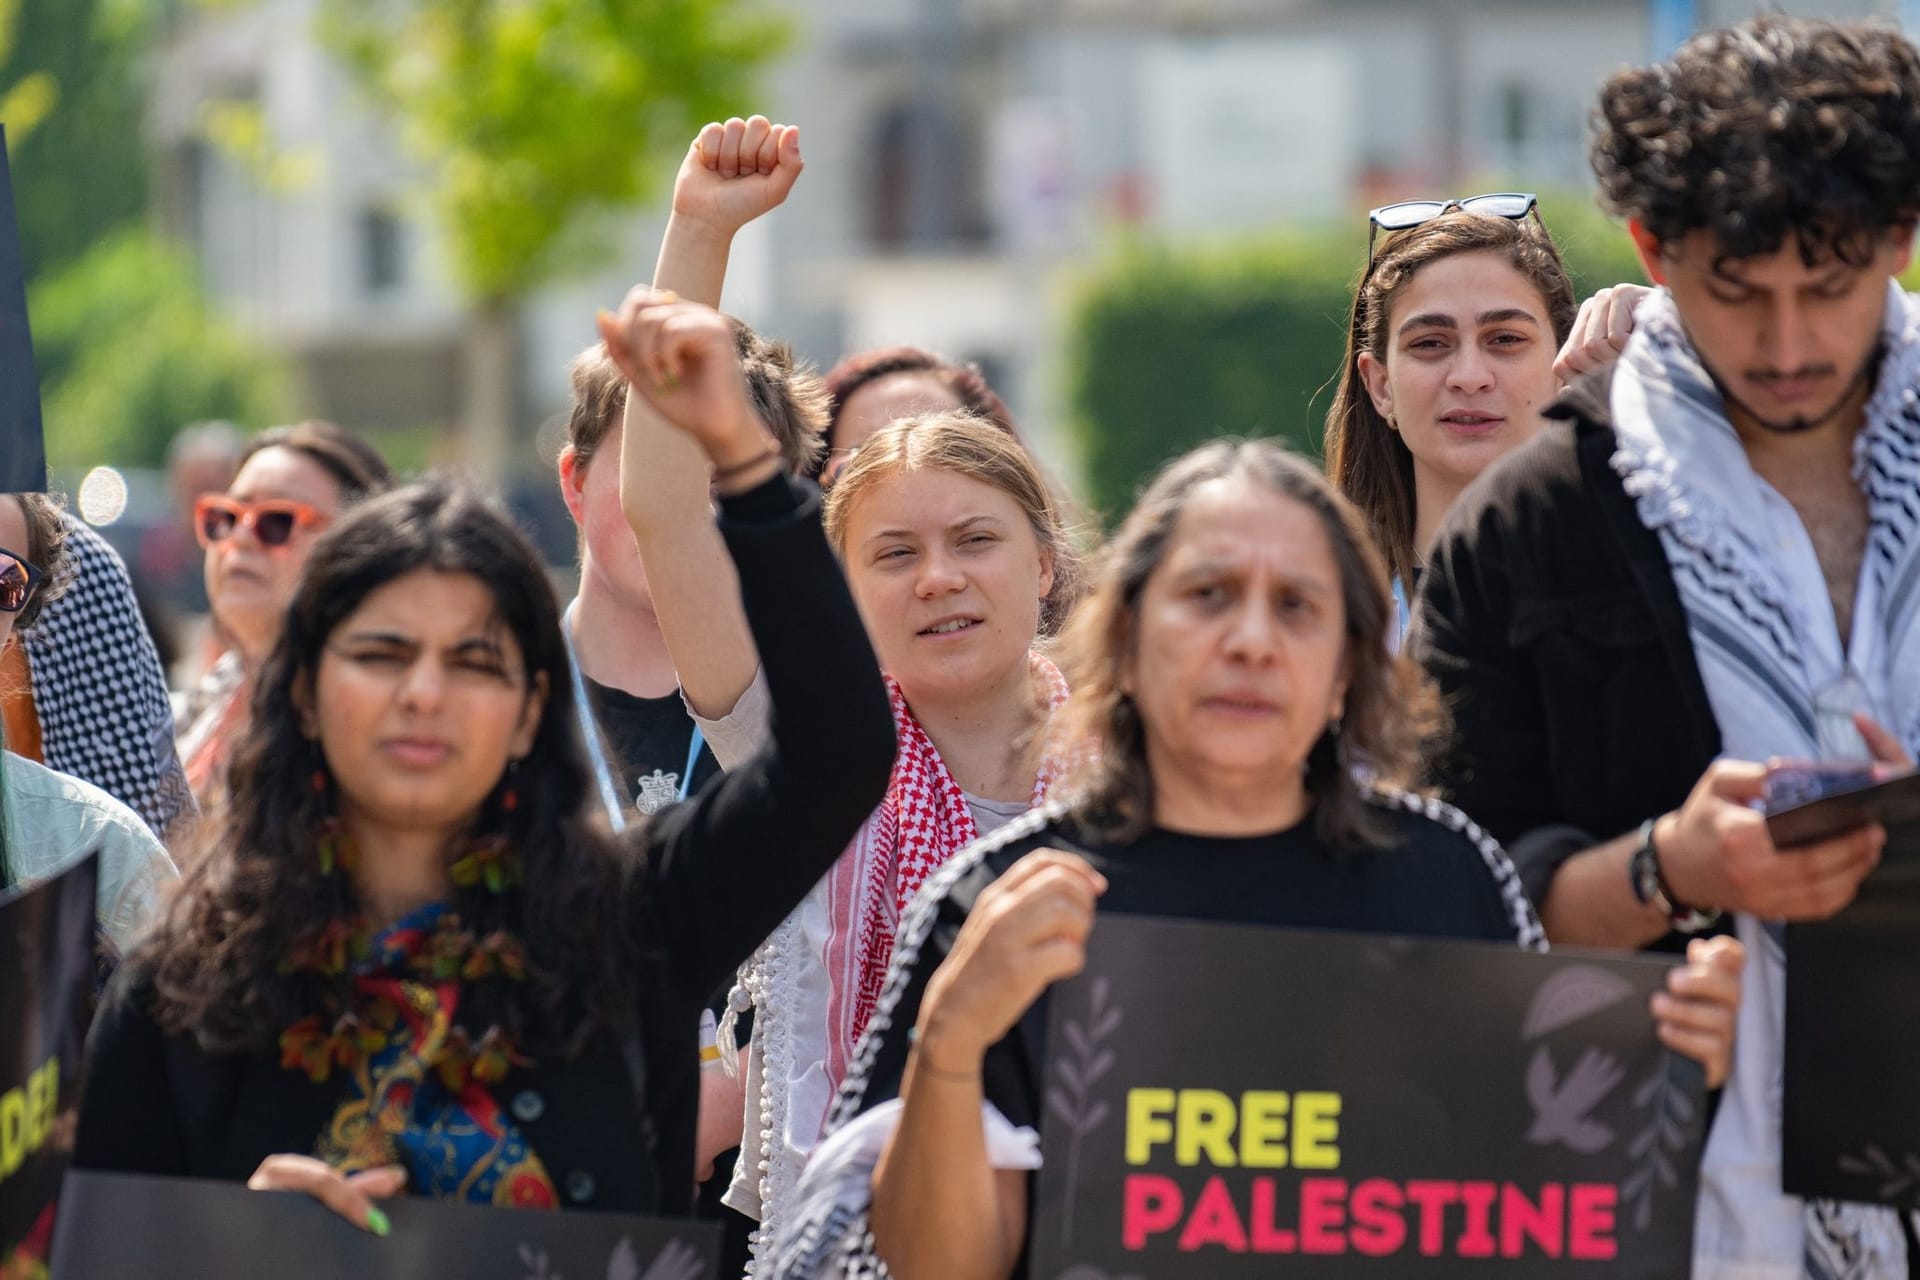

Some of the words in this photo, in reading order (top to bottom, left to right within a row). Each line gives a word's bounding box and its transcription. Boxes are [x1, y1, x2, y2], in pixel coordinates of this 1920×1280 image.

[0, 1055, 60, 1183] DE!
[1125, 1087, 1342, 1169] FREE
[1122, 1173, 1619, 1260] PALESTINE
